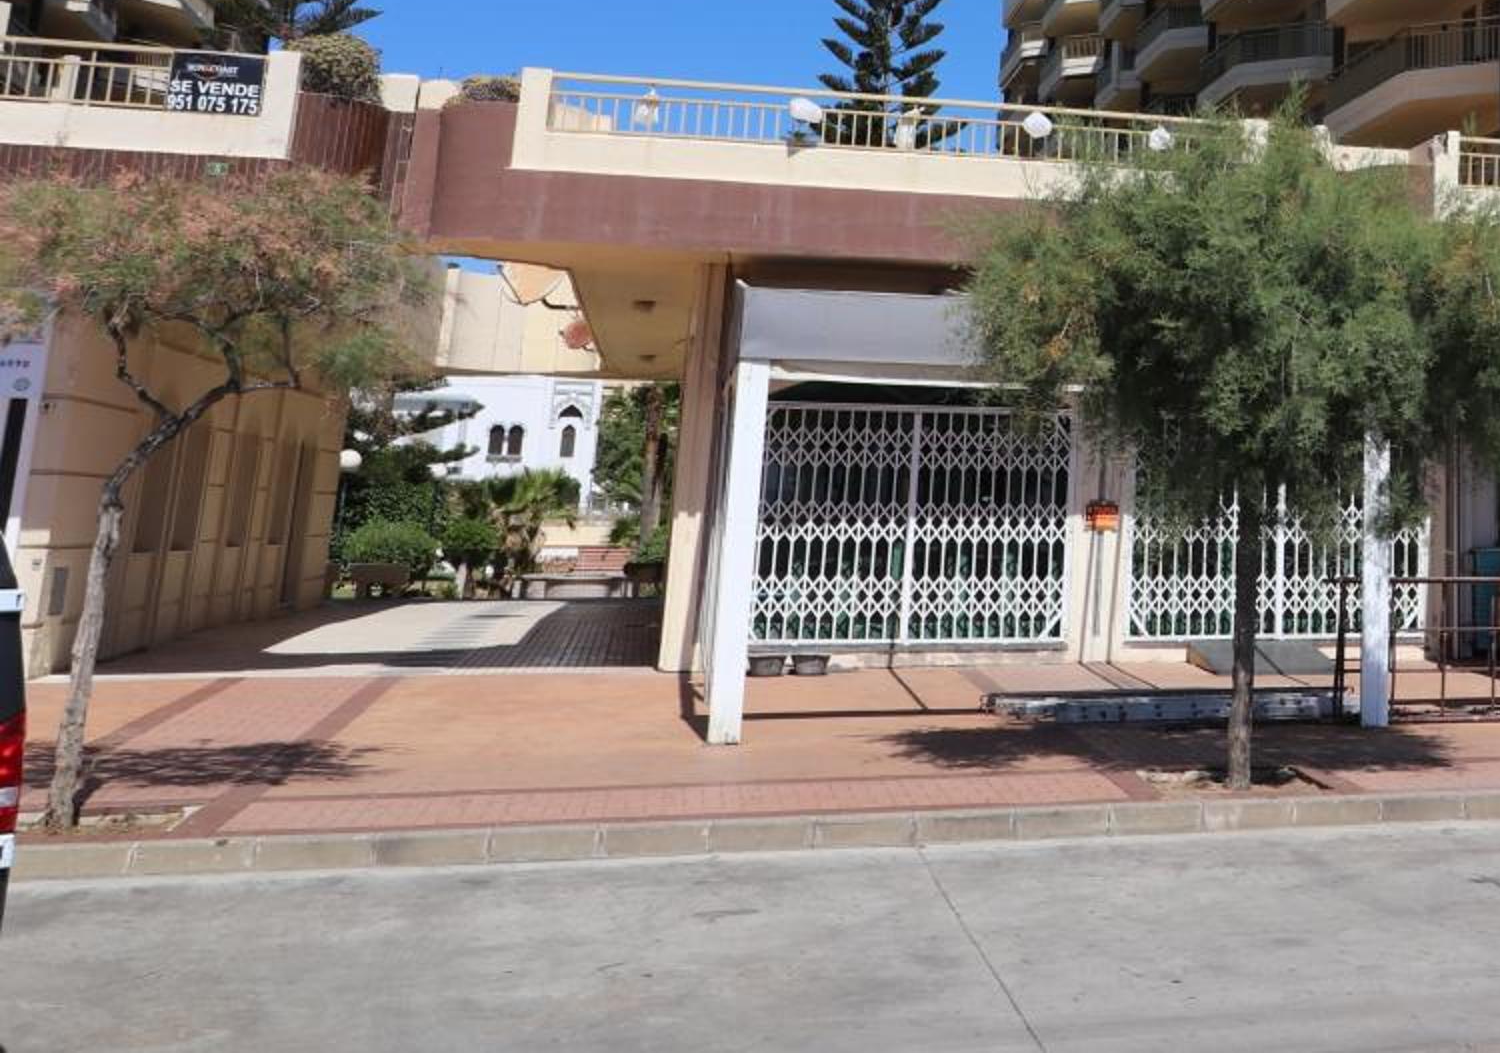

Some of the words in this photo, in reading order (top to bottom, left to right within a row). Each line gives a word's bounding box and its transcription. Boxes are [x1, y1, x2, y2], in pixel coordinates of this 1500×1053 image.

[170, 80, 193, 94] SE
[198, 81, 260, 98] VENDE
[167, 94, 193, 110] 951
[197, 95, 227, 113] 075
[231, 98, 258, 115] 175
